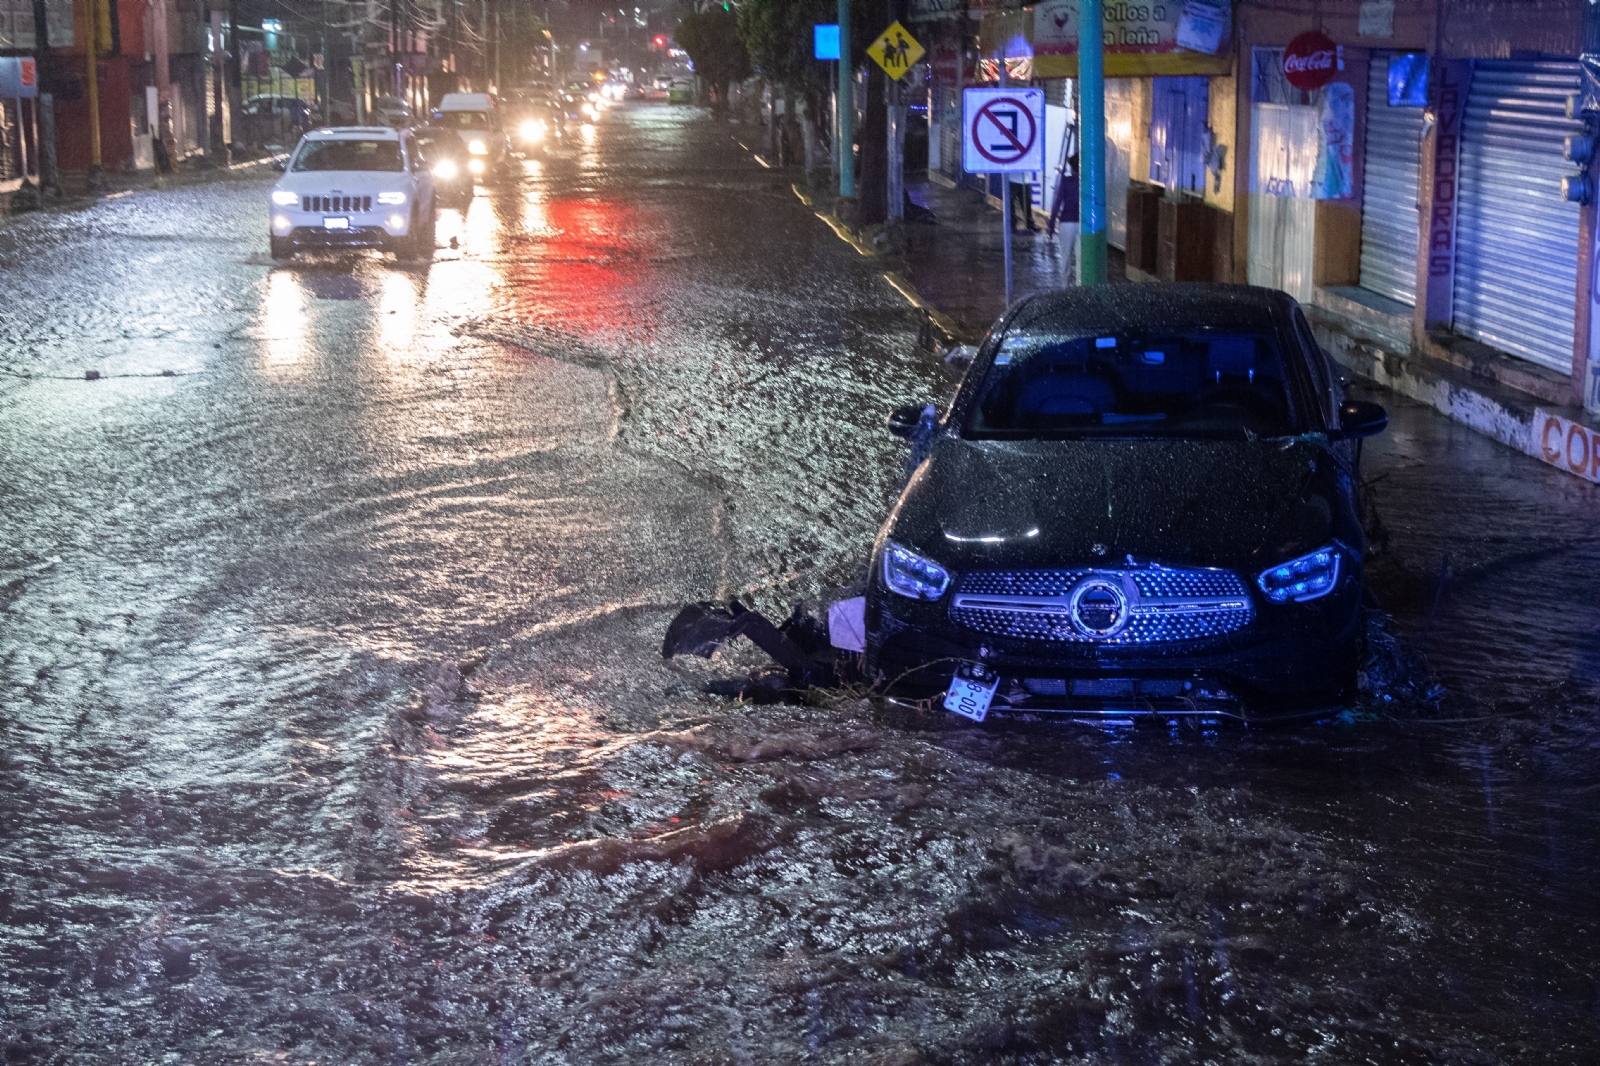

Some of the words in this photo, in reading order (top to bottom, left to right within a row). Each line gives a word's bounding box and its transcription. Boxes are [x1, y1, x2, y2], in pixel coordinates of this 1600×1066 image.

[1101, 3, 1149, 22] ollos
[1153, 5, 1166, 21] a
[1120, 26, 1159, 46] leña
[1430, 67, 1458, 277] LAVADORAS
